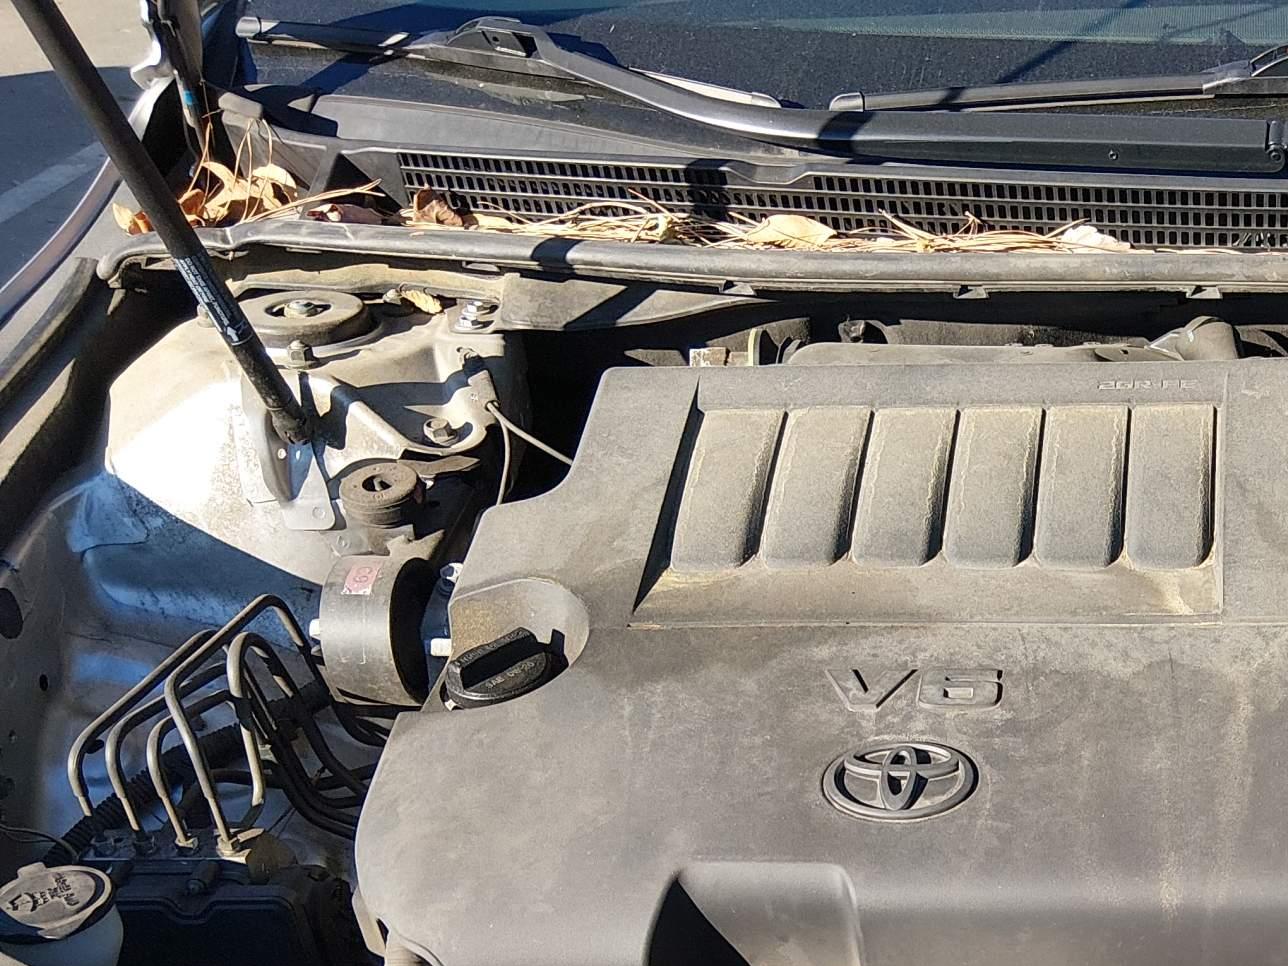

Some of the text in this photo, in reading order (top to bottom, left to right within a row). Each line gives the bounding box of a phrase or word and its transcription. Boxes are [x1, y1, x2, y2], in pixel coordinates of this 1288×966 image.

[1097, 379, 1198, 390] 2GR-FE
[485, 673, 506, 690] SAE
[825, 668, 1004, 711] V6
